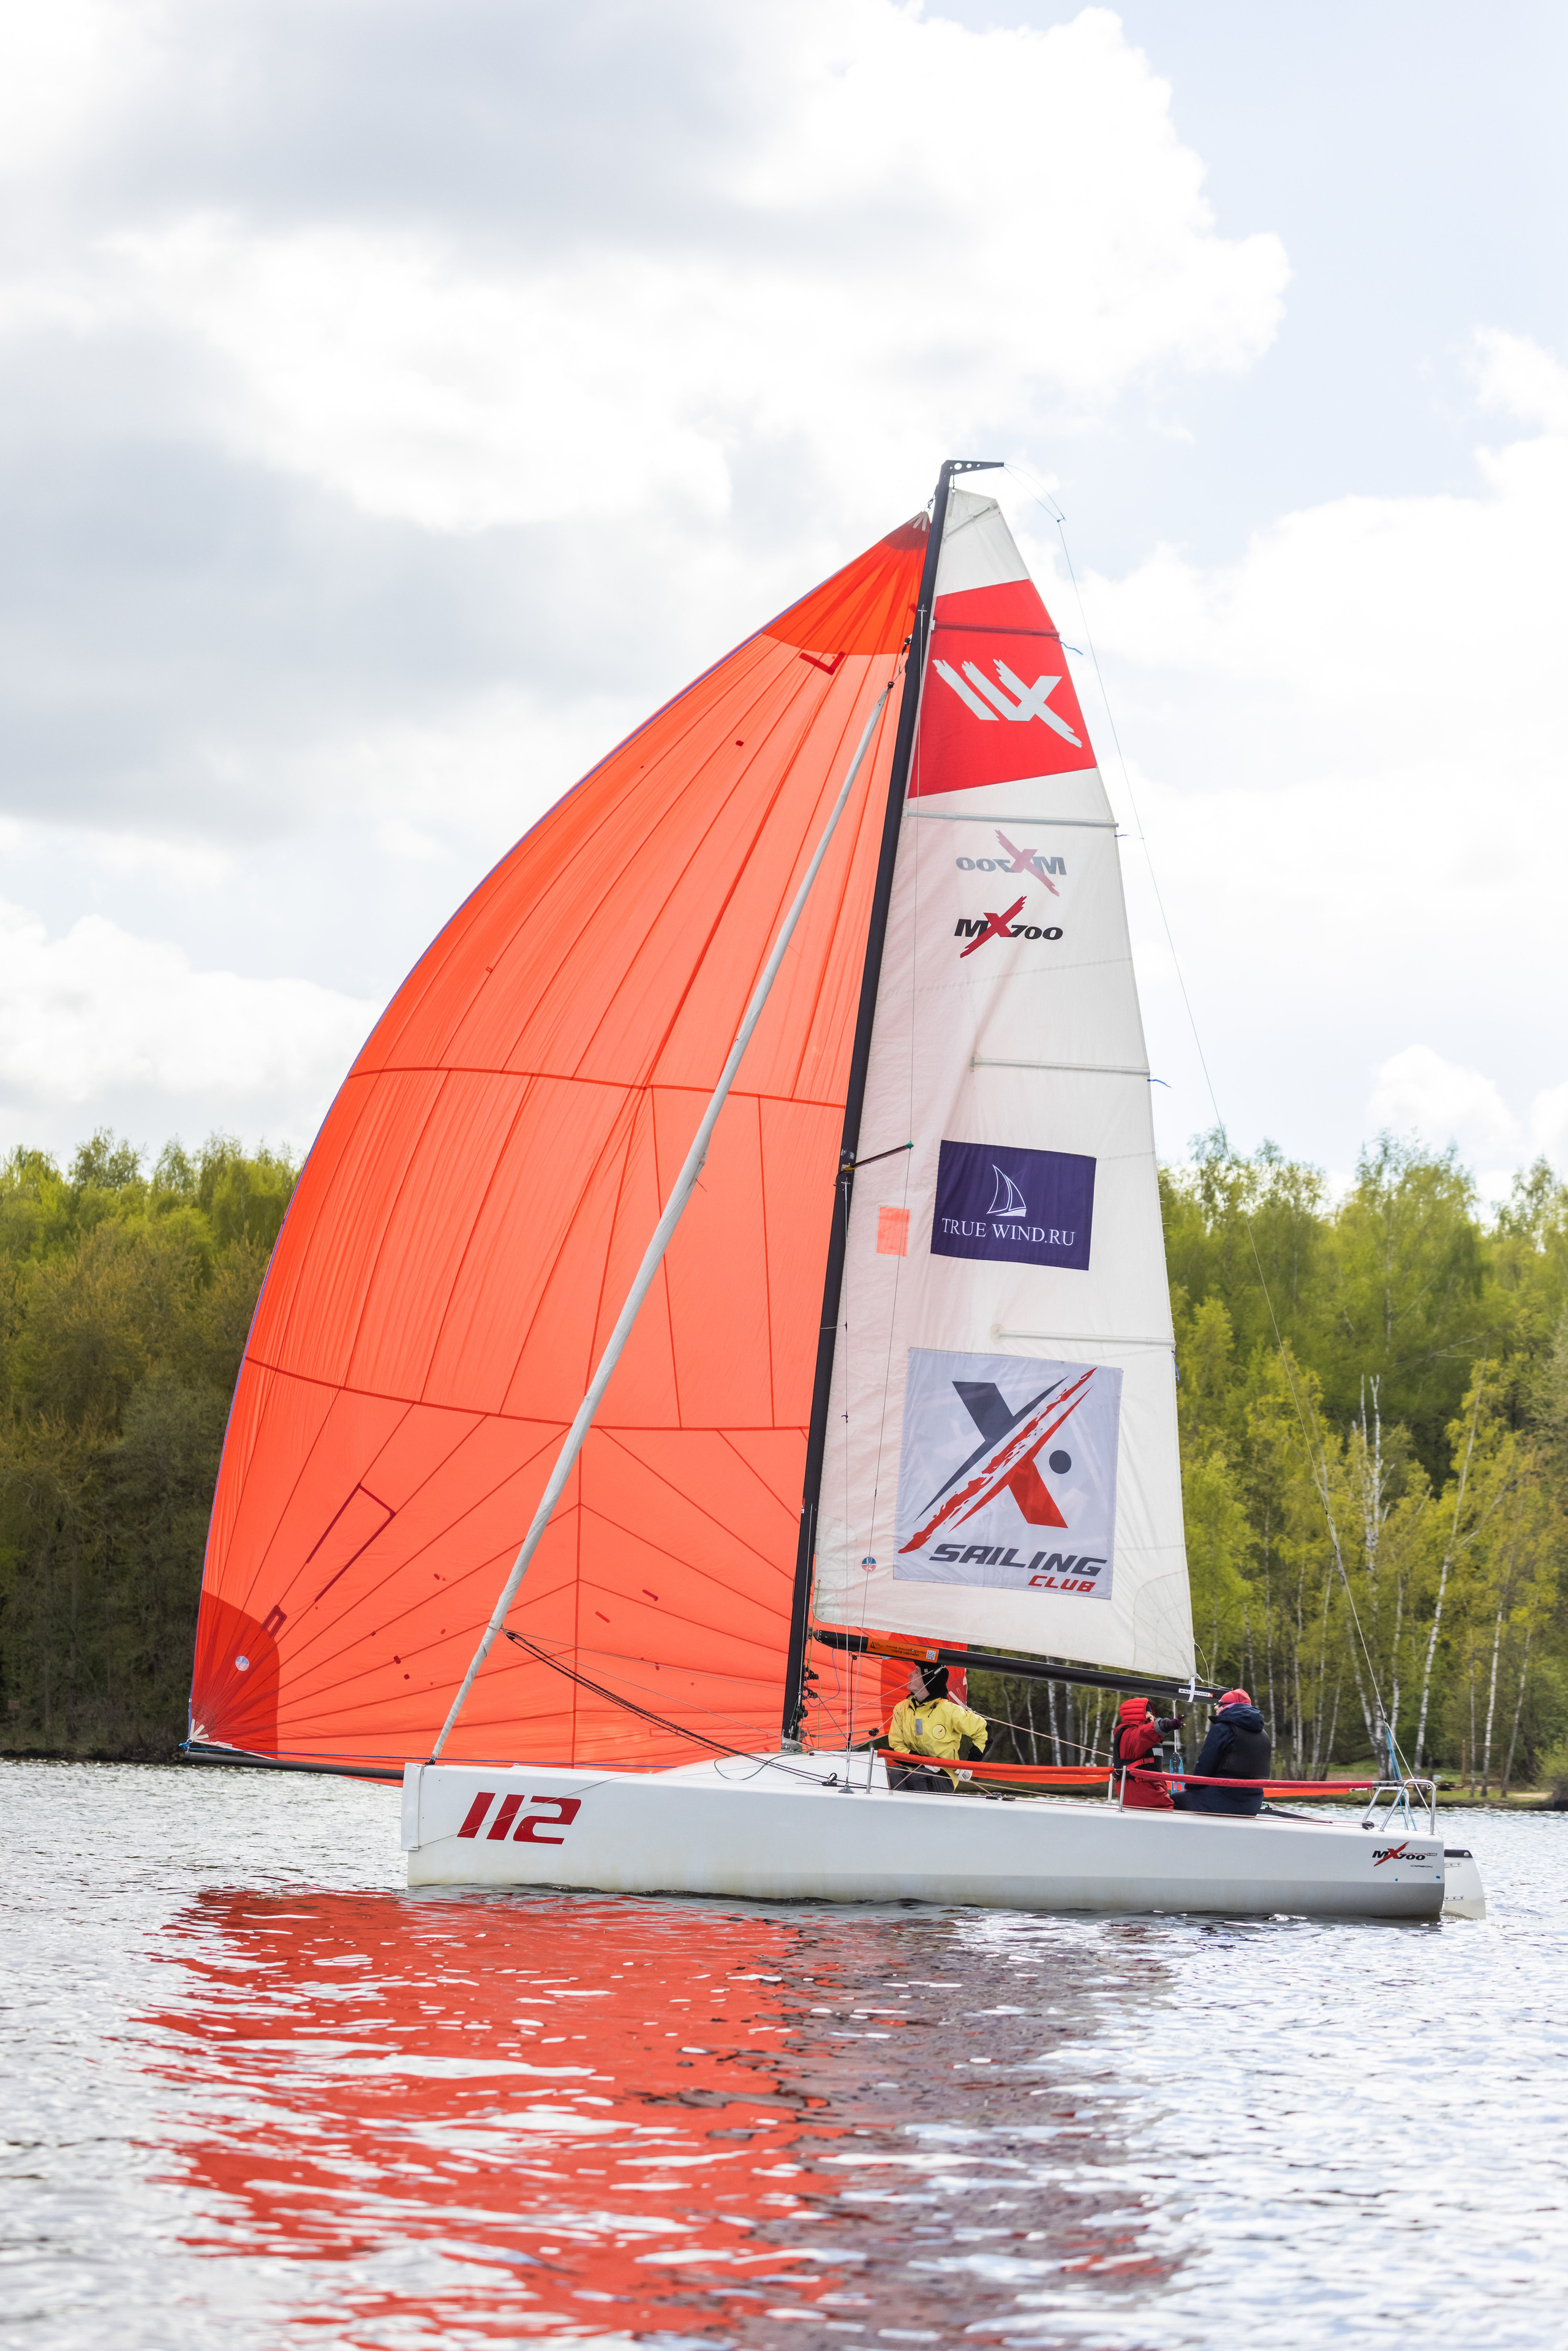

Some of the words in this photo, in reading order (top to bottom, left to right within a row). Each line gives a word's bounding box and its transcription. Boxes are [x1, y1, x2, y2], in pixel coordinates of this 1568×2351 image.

[954, 896, 1063, 959] MX700
[941, 1217, 987, 1237] TRUE
[992, 1223, 1076, 1246] WIND.RU
[928, 1543, 1107, 1577] SAILING
[1027, 1574, 1096, 1593] CLUB
[456, 1791, 582, 1845] 112
[1371, 1841, 1426, 1867] MX700
